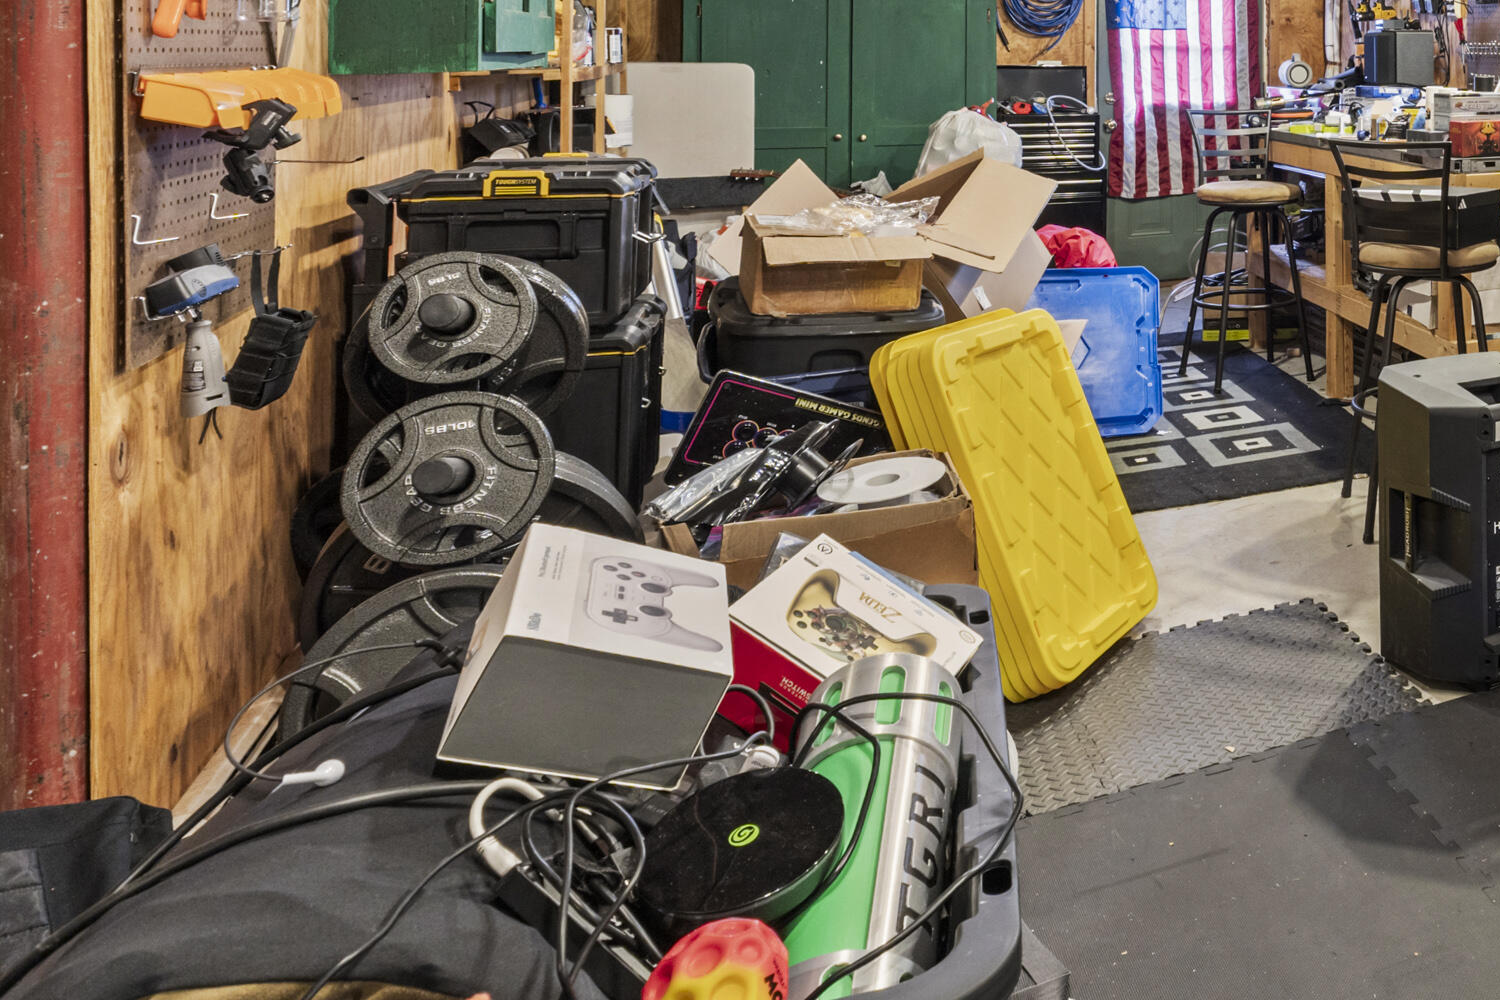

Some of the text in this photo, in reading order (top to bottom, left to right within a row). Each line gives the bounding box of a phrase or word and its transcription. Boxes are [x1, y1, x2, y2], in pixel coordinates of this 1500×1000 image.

[794, 398, 819, 411] MINI
[817, 404, 852, 419] GAMER
[424, 419, 477, 435] 10LBS
[439, 466, 498, 515] FITNESS
[858, 590, 903, 624] ZELDA
